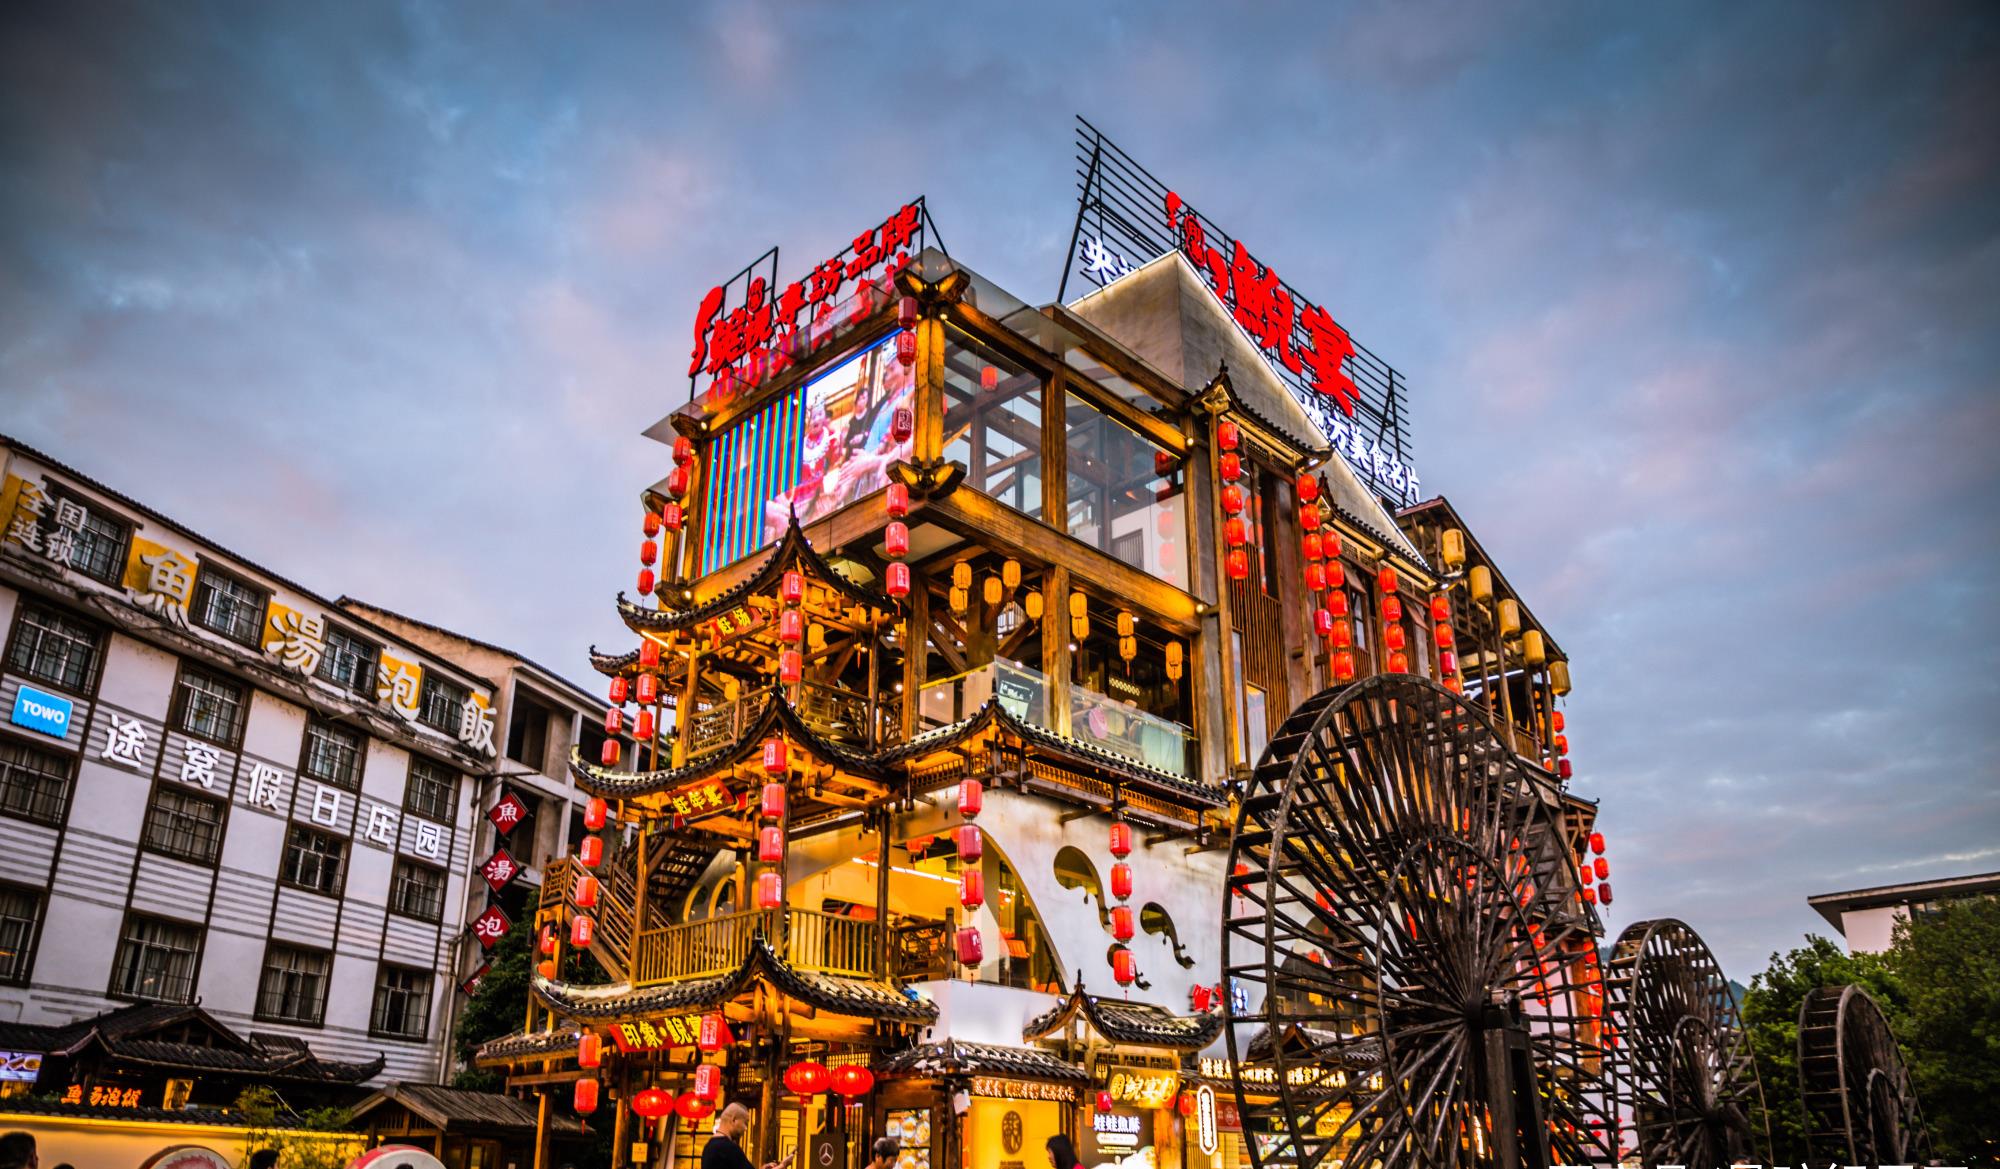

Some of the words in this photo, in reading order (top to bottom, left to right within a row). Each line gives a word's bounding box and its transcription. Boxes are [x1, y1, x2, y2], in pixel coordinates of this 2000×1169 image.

[18, 480, 88, 533] 全国
[8, 514, 75, 569] 连锁
[22, 699, 65, 724] TOWO
[101, 713, 442, 859] 途窝假日庄园
